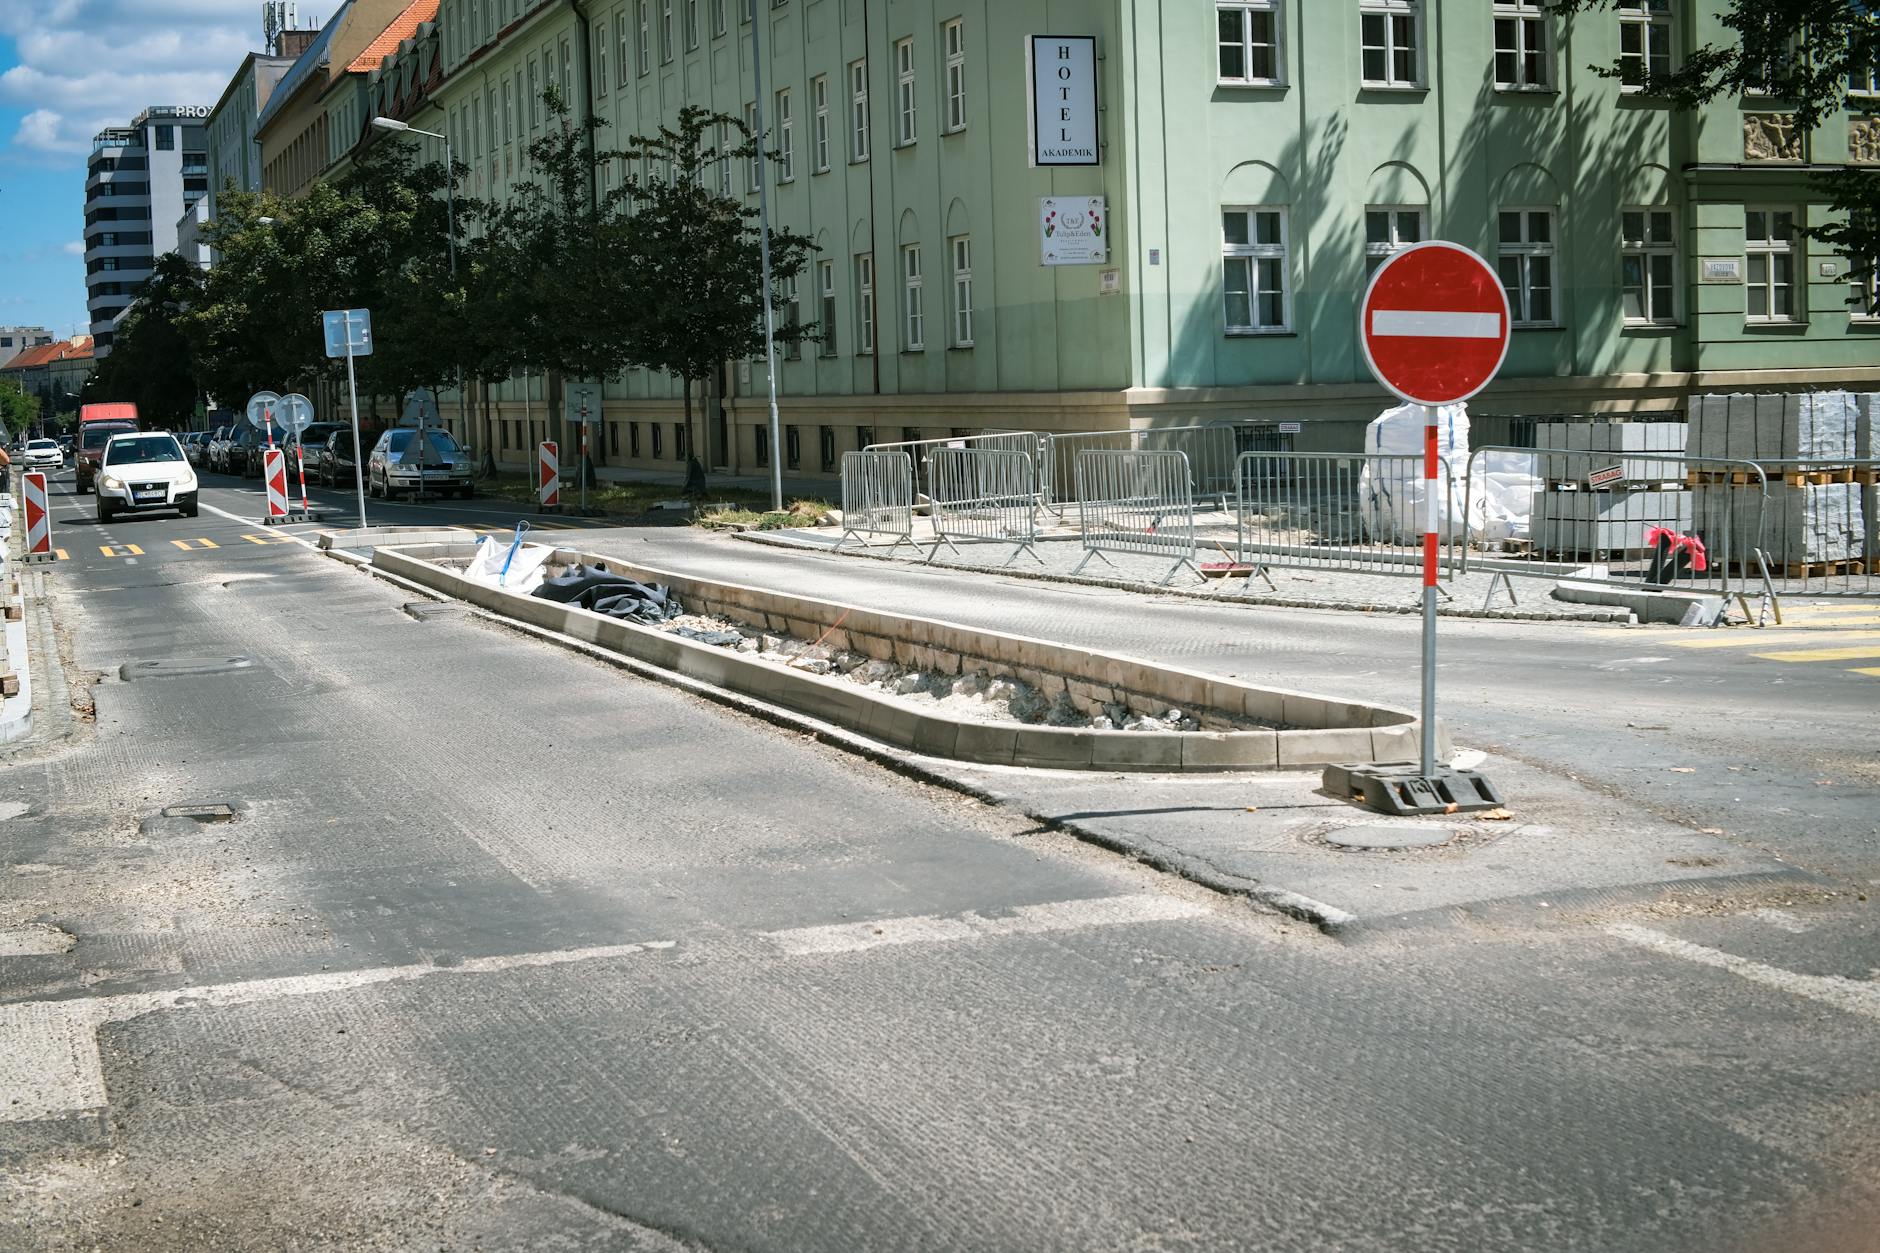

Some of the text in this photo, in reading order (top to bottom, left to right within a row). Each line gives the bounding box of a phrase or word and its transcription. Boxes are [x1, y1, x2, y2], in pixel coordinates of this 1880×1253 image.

[1058, 46, 1072, 142] HOTEL
[176, 106, 212, 118] PRO
[1042, 148, 1094, 157] AKADEMIK
[1591, 469, 1622, 484] STRABAG
